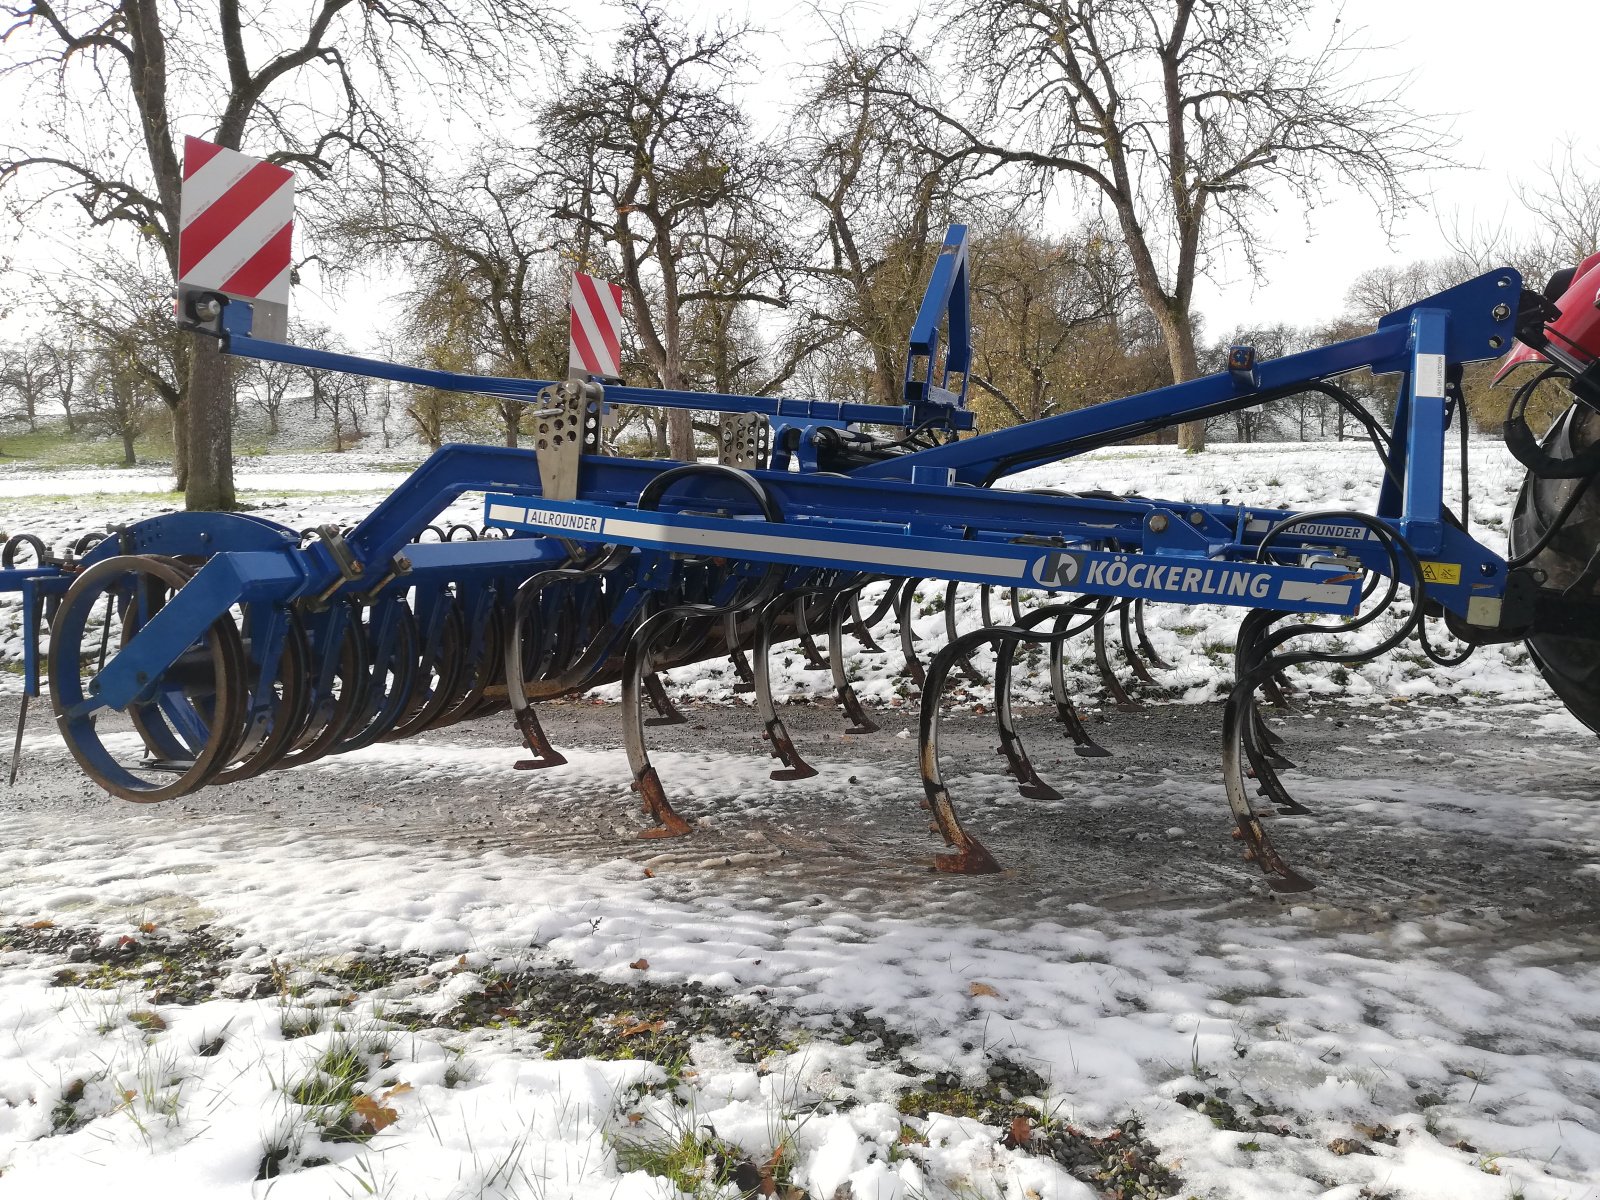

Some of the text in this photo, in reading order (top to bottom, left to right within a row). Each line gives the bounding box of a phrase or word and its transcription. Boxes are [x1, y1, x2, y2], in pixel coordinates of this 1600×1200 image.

[531, 511, 597, 531] ALLROUNDER
[1283, 522, 1361, 538] LLROUNDER
[1086, 555, 1272, 597] KÖCKERLING
